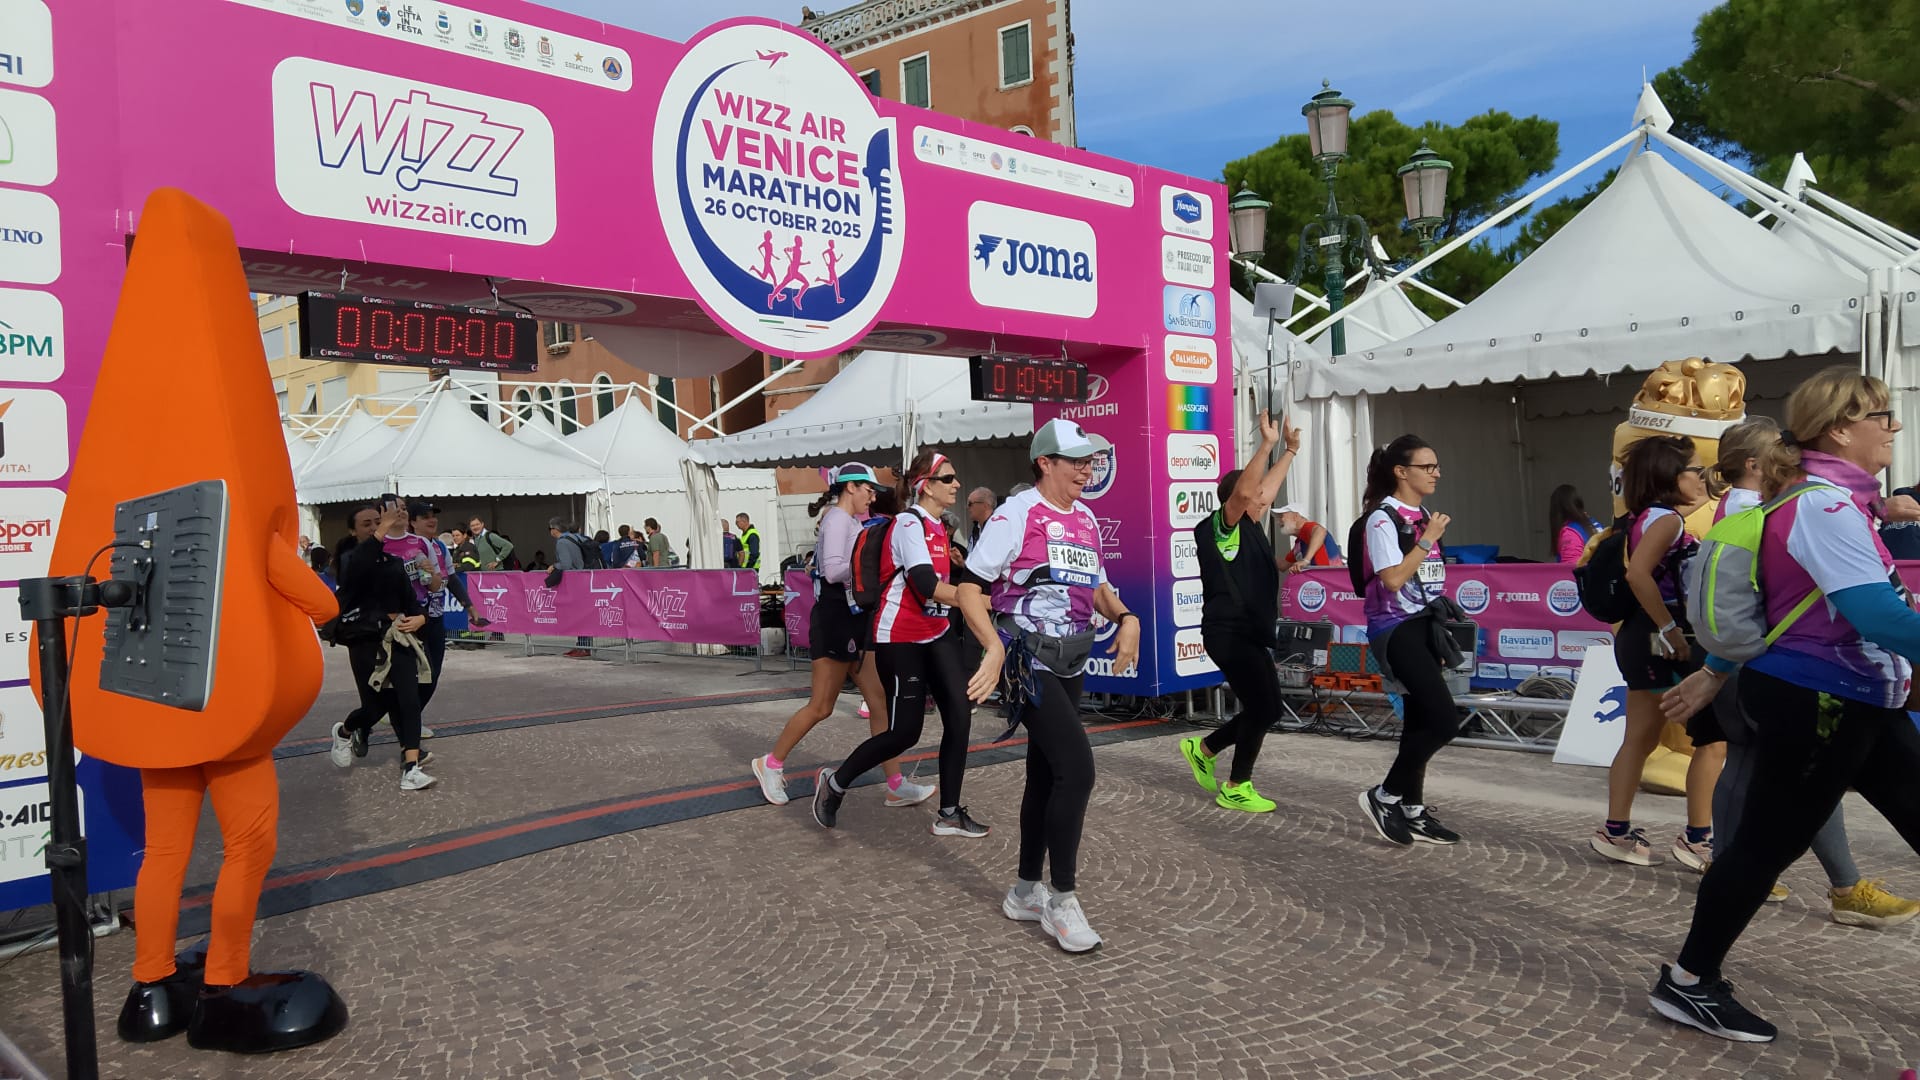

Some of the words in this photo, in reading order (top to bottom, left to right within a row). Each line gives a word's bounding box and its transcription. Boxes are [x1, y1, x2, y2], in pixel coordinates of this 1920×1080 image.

[397, 23, 422, 36] FESTA
[565, 61, 594, 74] ESERCITO
[714, 88, 791, 132] WIZZ
[800, 112, 846, 144] AIR
[702, 118, 860, 188] VENICE
[703, 163, 861, 216] MARATHON
[366, 194, 528, 236] wizzair.com
[1175, 200, 1199, 214] Hampton
[705, 197, 727, 216] 26
[731, 202, 817, 232] OCTOBER
[822, 218, 861, 239] 2025
[1002, 238, 1094, 283] Joma
[337, 306, 515, 359] 00:00:00
[1060, 403, 1119, 420] HYUNDAI
[1176, 404, 1209, 413] MASSIGEN
[1170, 455, 1212, 470] deporvillage
[1191, 491, 1214, 513] TAO
[1061, 548, 1089, 568] 18423
[1500, 635, 1540, 645] Bavaria
